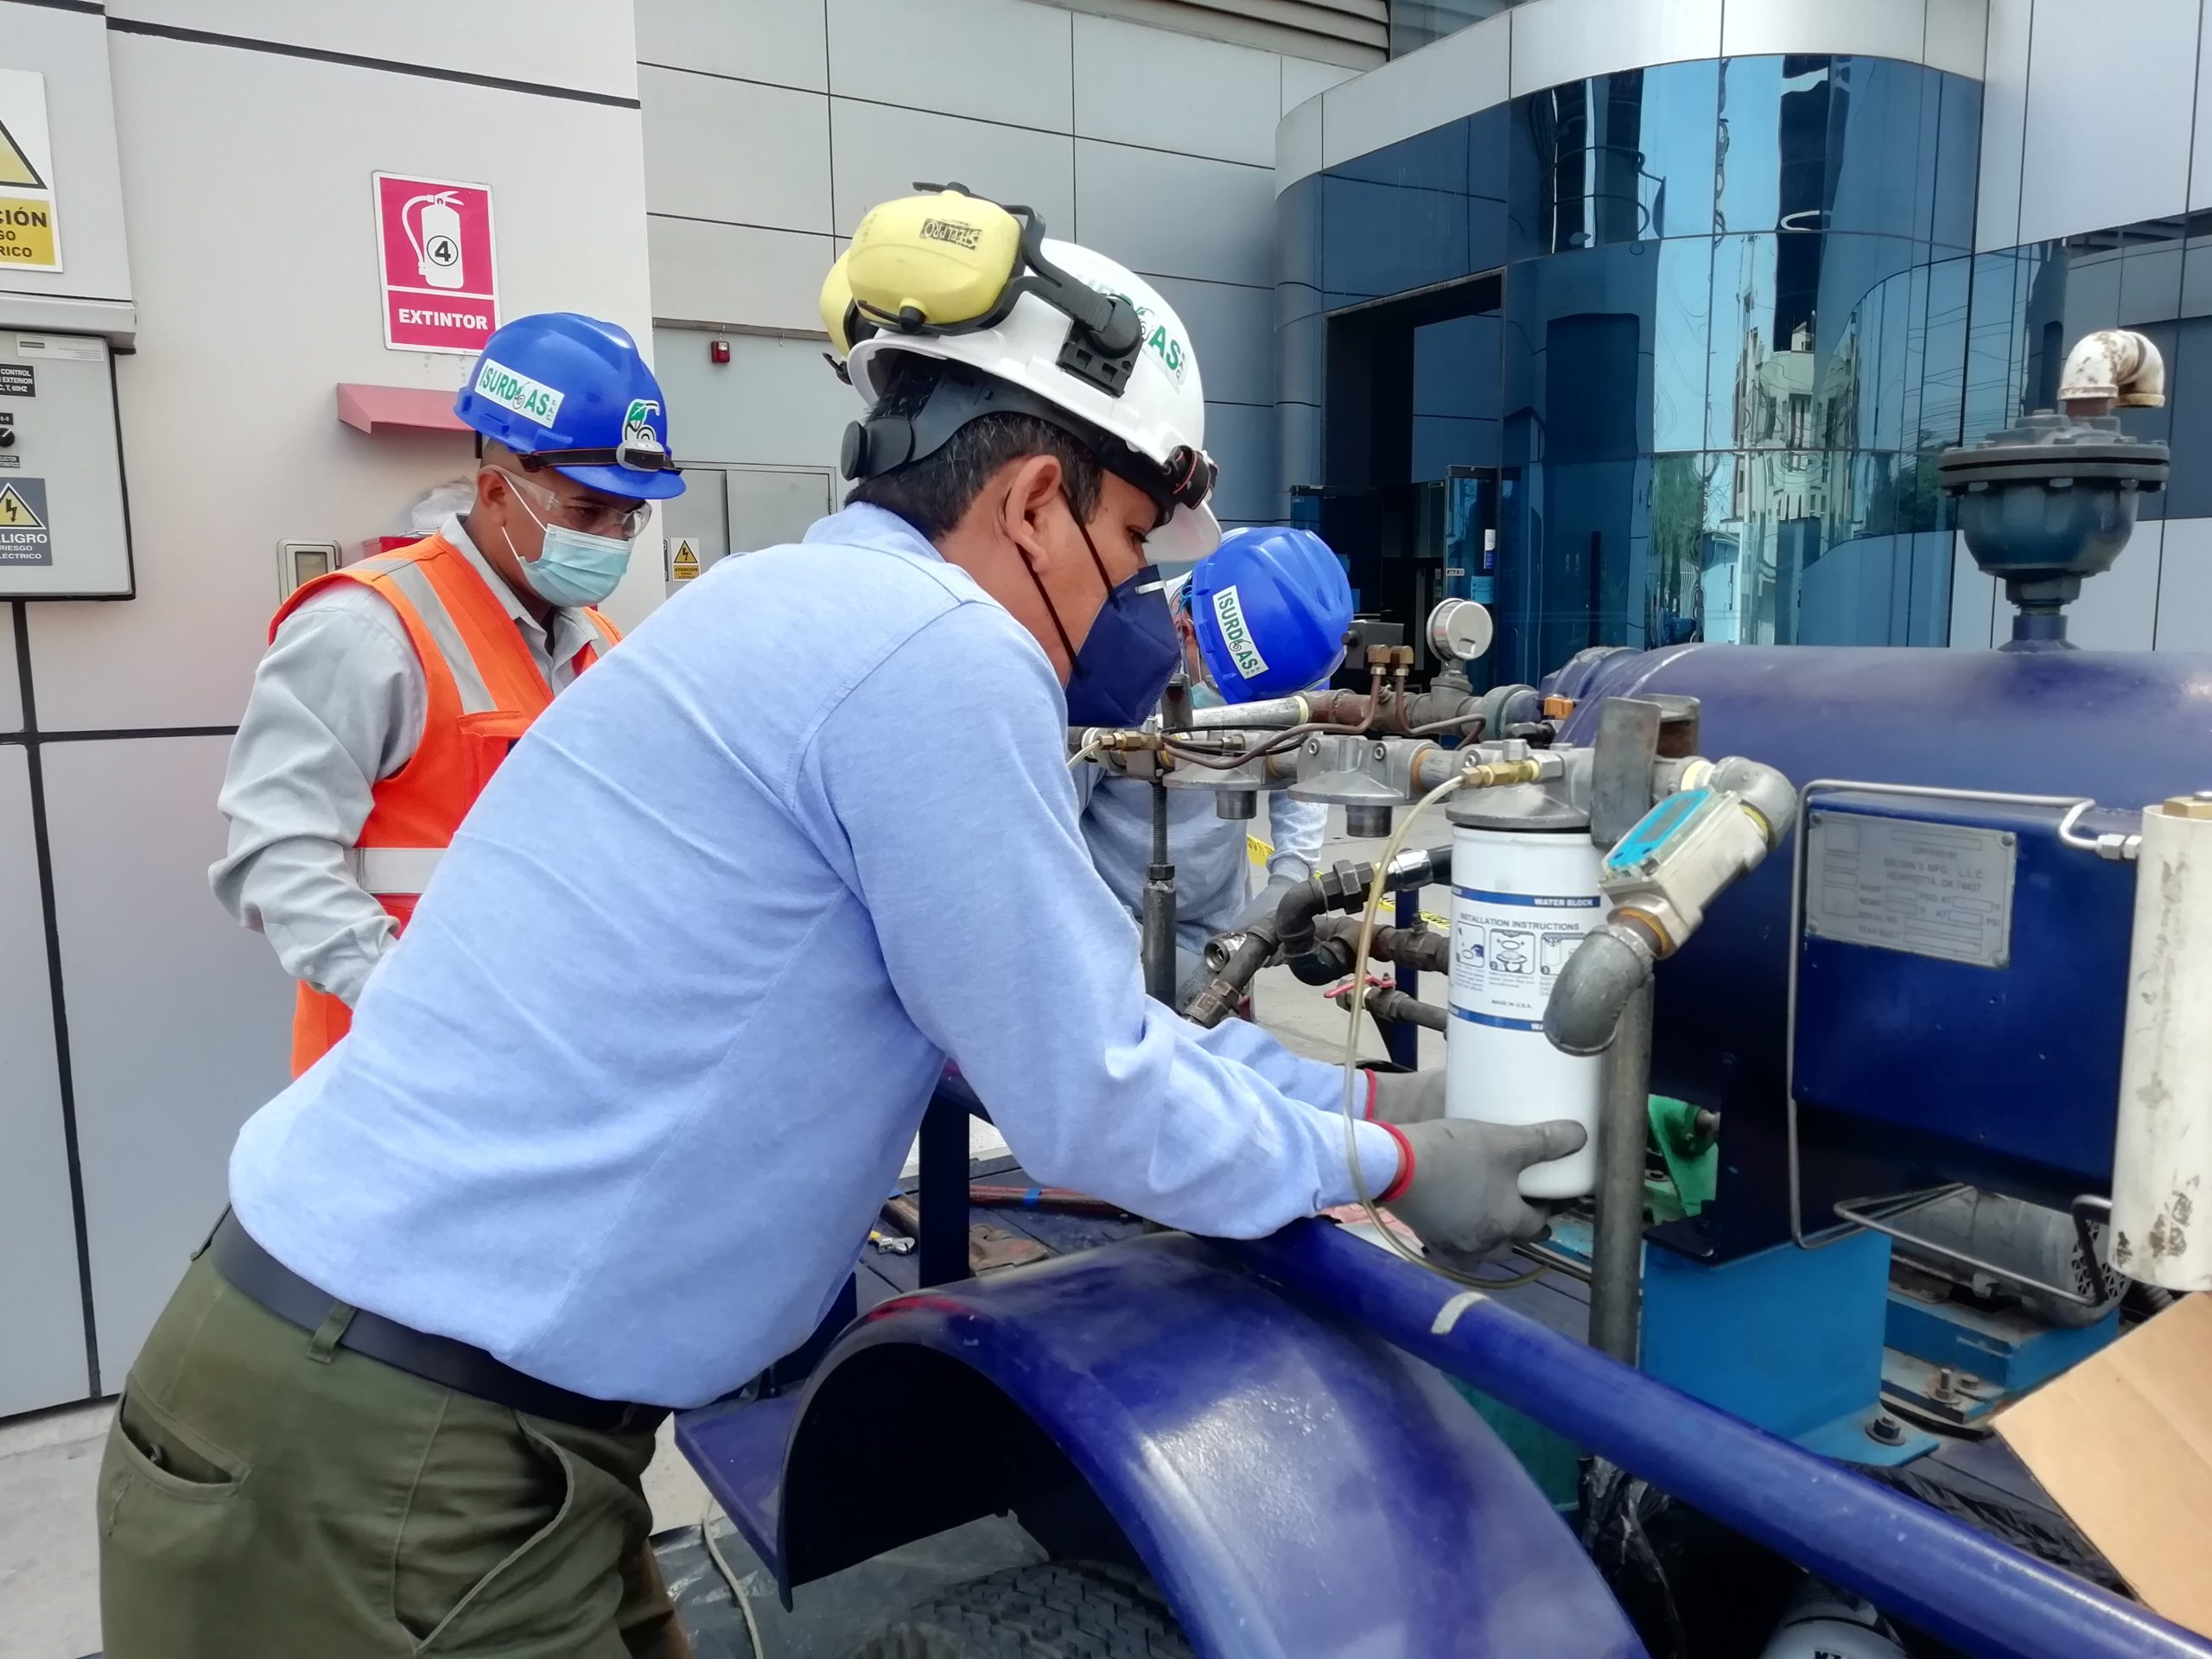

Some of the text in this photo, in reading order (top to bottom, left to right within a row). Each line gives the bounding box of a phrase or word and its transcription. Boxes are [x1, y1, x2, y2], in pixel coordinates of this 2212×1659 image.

[435, 240, 451, 262] 4
[398, 308, 488, 330] EXTINTOR
[1, 368, 31, 377] CONTROL
[3, 376, 34, 385] EXTERIOR
[0, 533, 48, 543] LIGRO
[1534, 898, 1565, 906] WATER
[1511, 920, 1580, 931] INSTRUCTIONS
